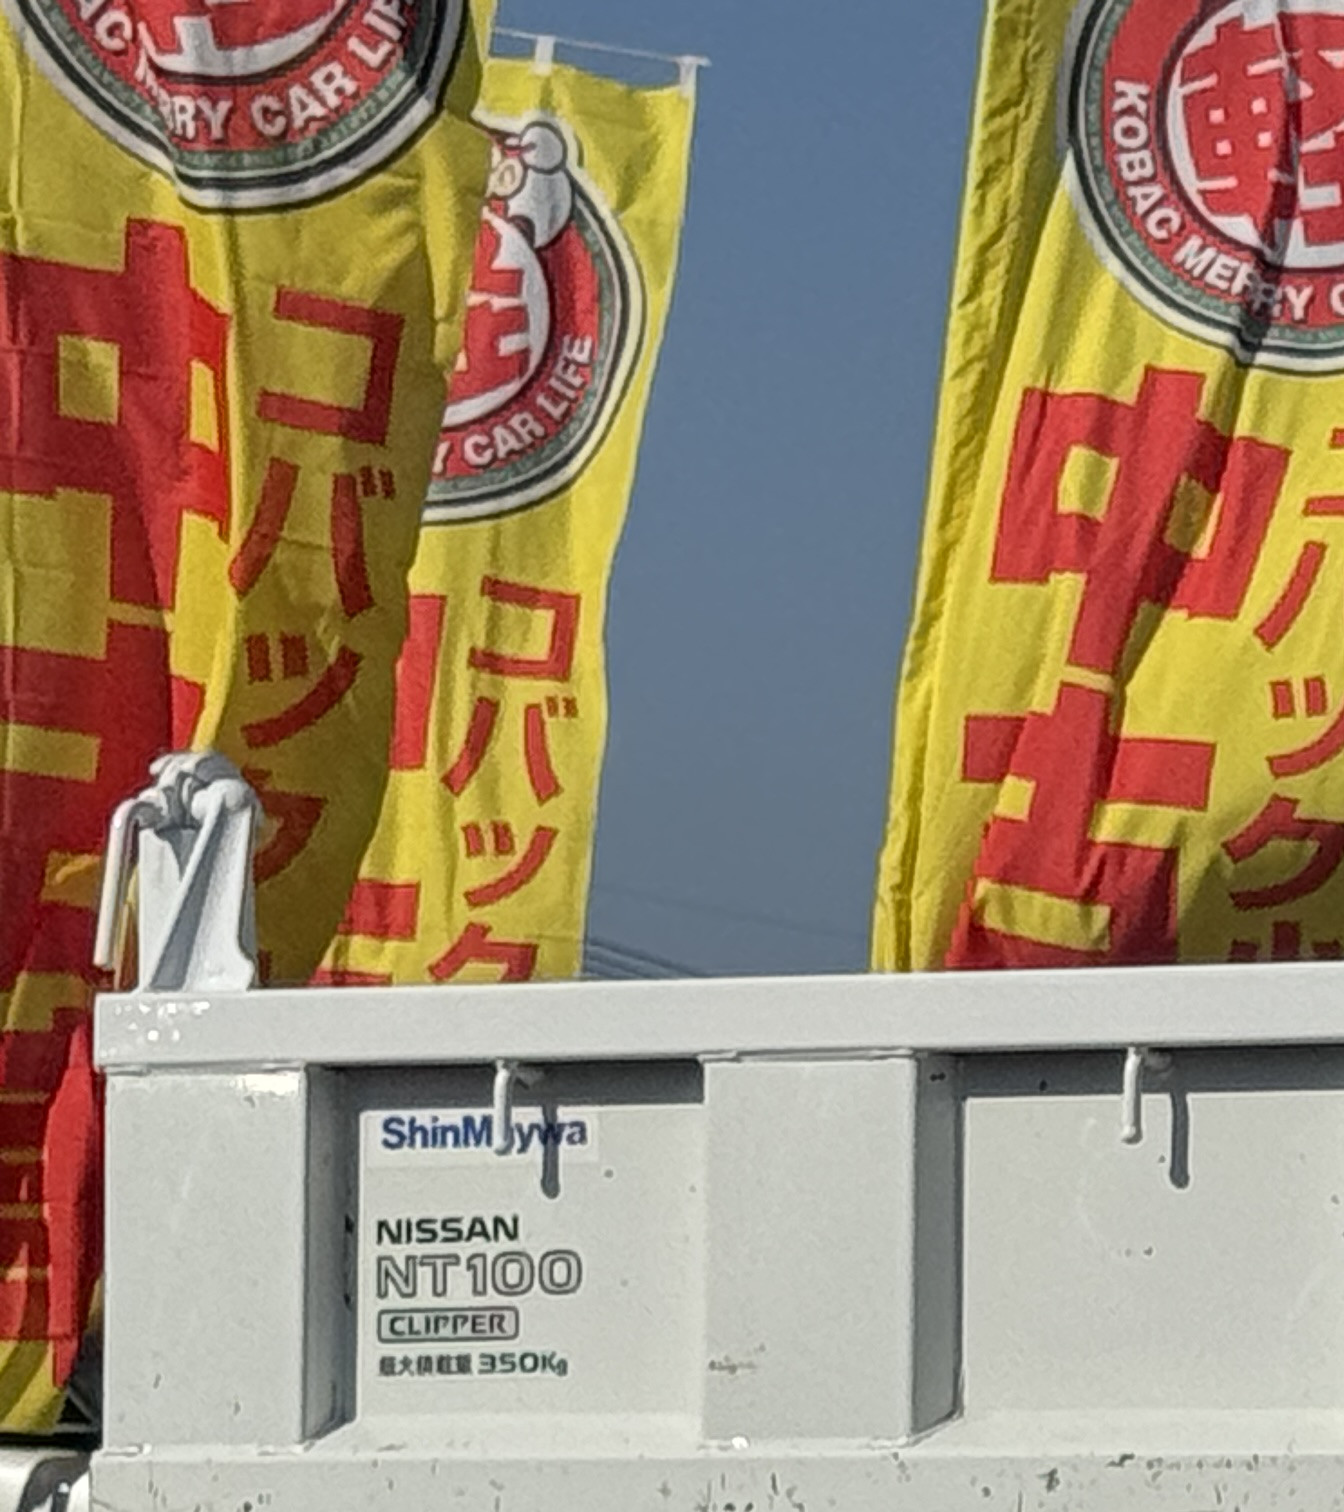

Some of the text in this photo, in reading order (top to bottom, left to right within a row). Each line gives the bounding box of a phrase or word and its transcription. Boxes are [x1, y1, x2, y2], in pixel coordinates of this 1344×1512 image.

[250, 62, 358, 137] CAR
[1112, 79, 1182, 240] KOBAC
[464, 409, 546, 467] CAR
[537, 332, 593, 420] LIFE
[381, 1113, 589, 1155] ShinMywa
[376, 1214, 519, 1245] NISSAN
[376, 1250, 582, 1299] NT100
[388, 1313, 508, 1337] CLIPPER
